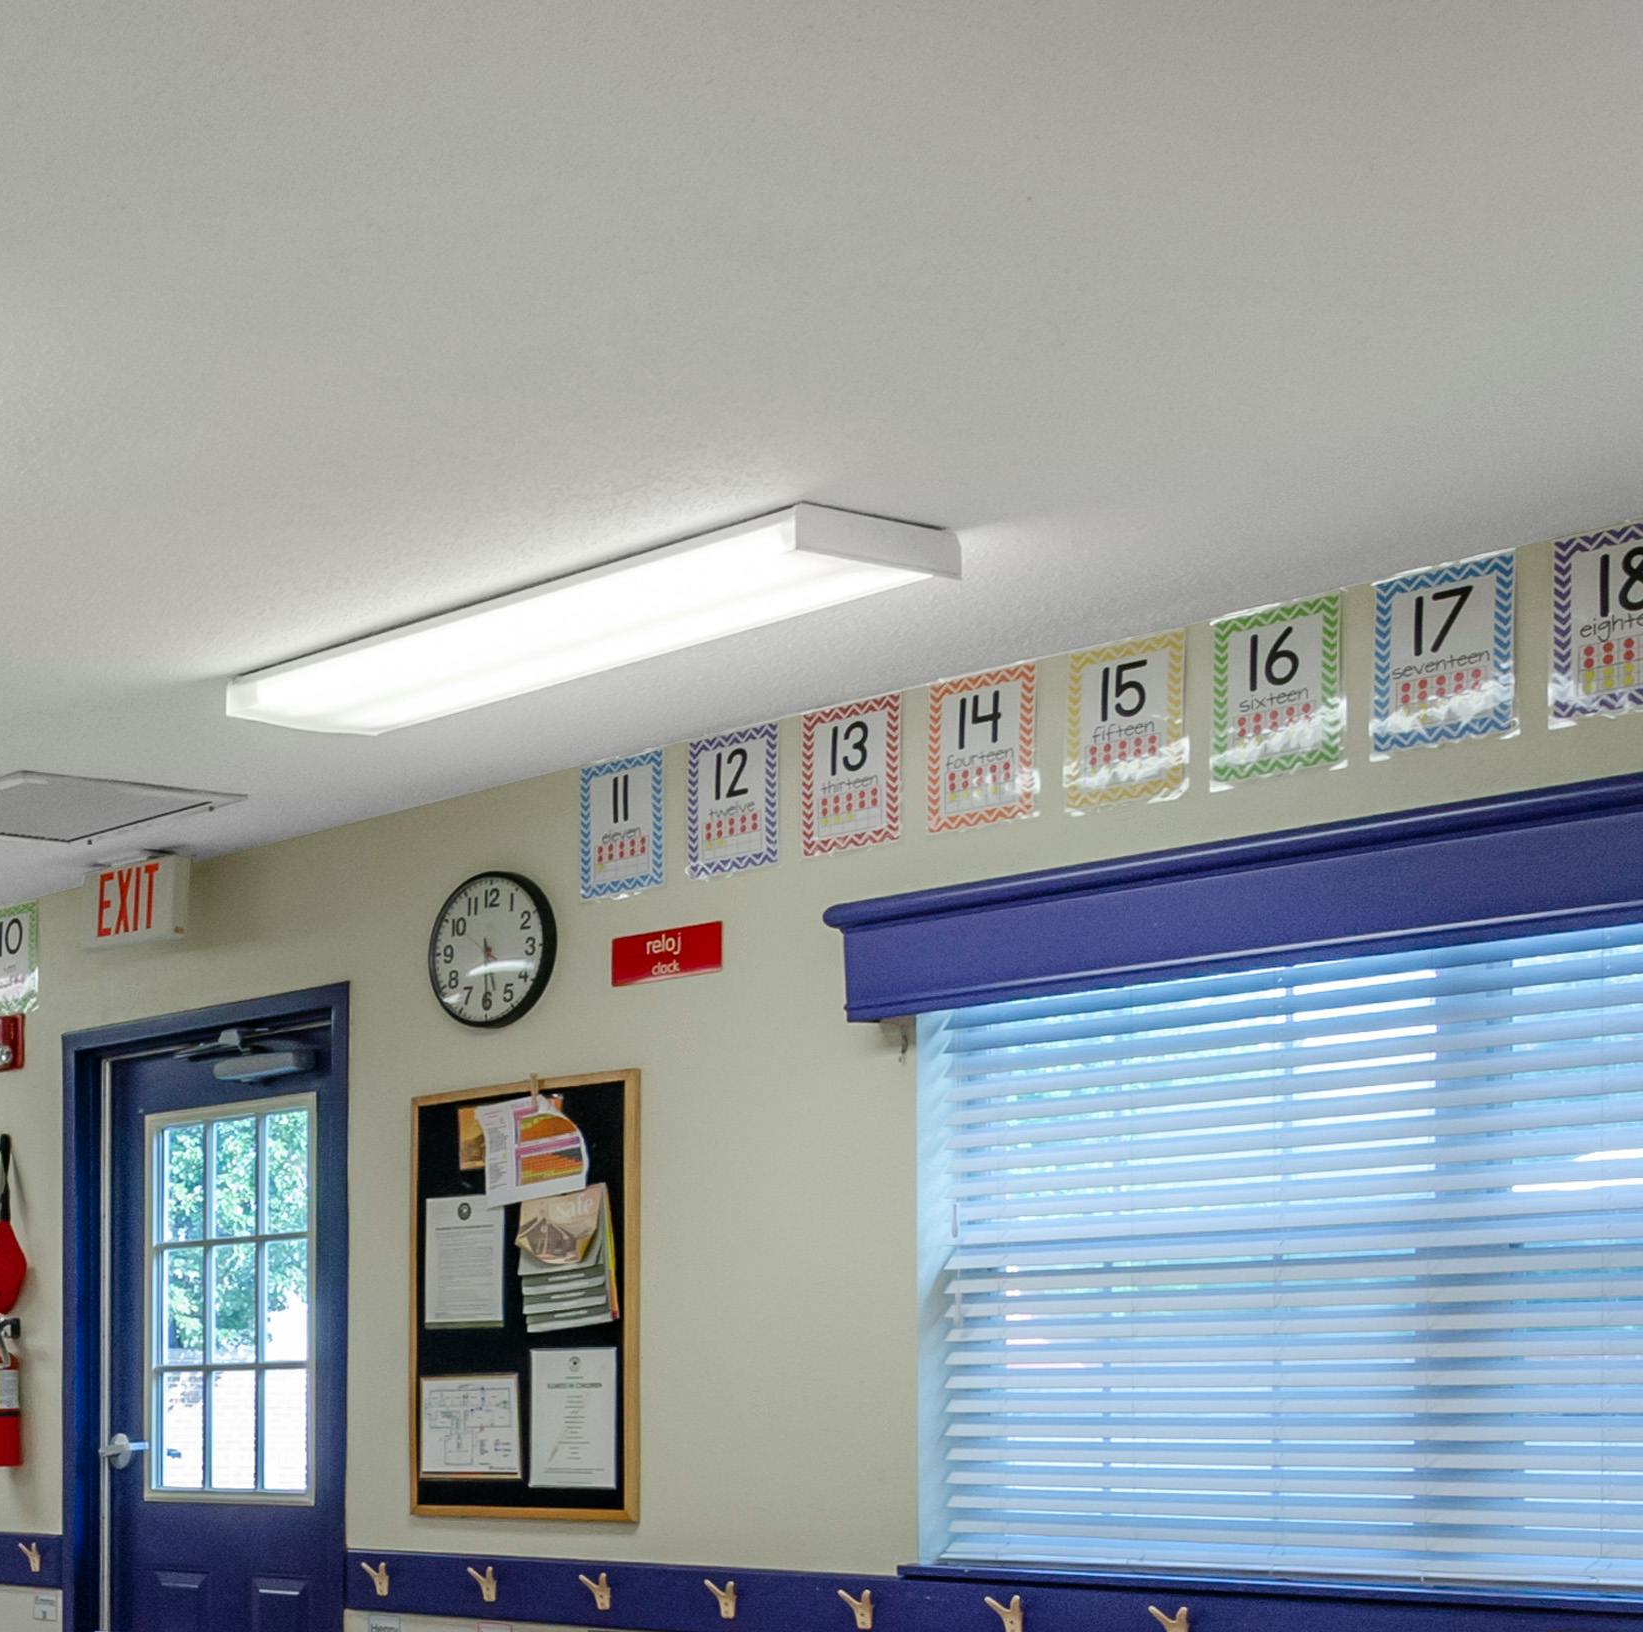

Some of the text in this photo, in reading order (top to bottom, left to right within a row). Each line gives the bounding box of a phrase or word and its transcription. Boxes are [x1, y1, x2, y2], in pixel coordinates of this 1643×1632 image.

[1414, 585, 1473, 656] 17
[1249, 626, 1299, 691] 16
[1391, 650, 1490, 680] seventeen
[1101, 659, 1147, 721] 15
[1238, 686, 1310, 713] sixteen
[958, 690, 1001, 749] 14
[1092, 719, 1155, 742] fifteen
[830, 721, 869, 776] 13
[945, 746, 1015, 771] fourteen
[715, 748, 748, 800] 12
[821, 774, 879, 795] thirteen
[612, 774, 629, 824] 11
[708, 801, 756, 820] twelve
[601, 826, 642, 845] eleven
[97, 863, 160, 937] EXIT
[467, 897, 478, 916] 11
[484, 888, 500, 909] 12
[509, 893, 514, 911] 1
[451, 917, 466, 937] 10
[519, 910, 531, 930] 2
[525, 937, 536, 956] 3
[645, 932, 682, 955] reloj
[443, 945, 454, 964] 9
[518, 968, 529, 982] 4
[651, 959, 680, 976] clock
[448, 970, 459, 989] 8
[463, 986, 473, 1005] 7
[482, 992, 492, 1011] 6
[503, 983, 514, 1002] 5
